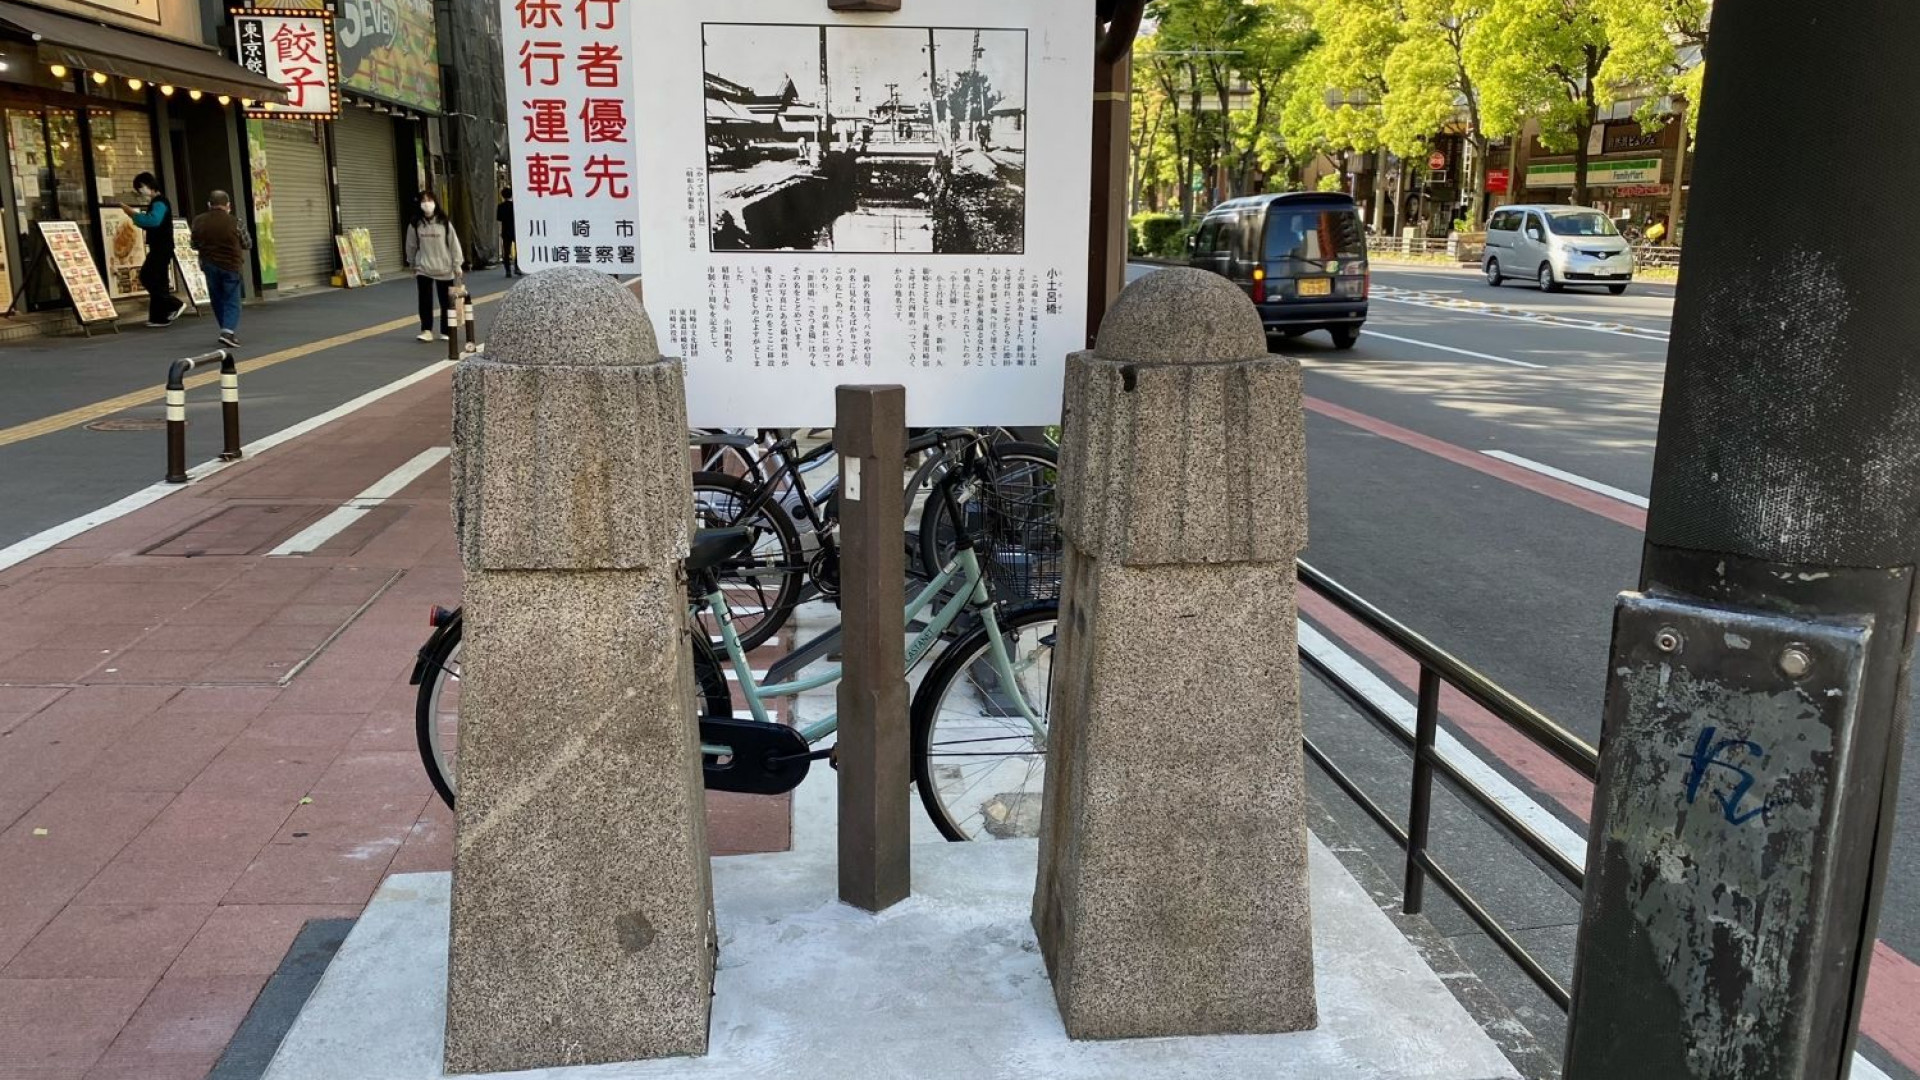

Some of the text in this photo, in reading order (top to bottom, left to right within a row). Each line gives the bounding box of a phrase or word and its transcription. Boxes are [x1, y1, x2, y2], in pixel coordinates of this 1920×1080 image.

[270, 22, 325, 107] 餃子
[1613, 170, 1643, 180] FamilyMart
[529, 219, 634, 238] 川崎市
[531, 246, 635, 263] 川崎警察署
[1046, 267, 1058, 315] 小土呂橋
